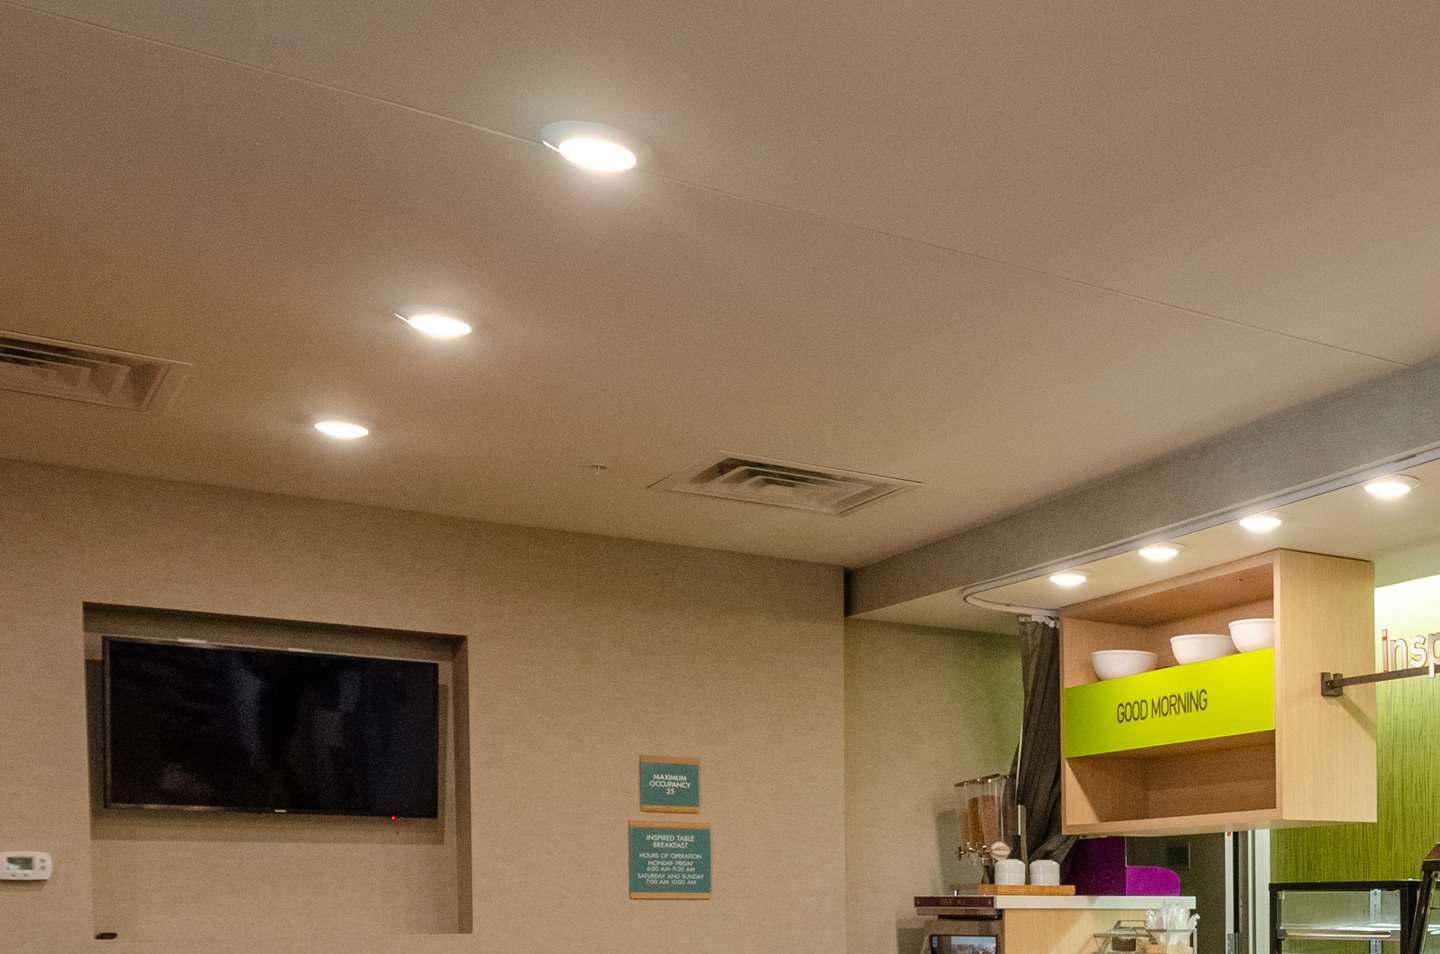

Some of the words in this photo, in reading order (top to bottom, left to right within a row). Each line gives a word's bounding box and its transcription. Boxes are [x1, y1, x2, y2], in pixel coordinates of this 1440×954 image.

[1117, 700, 1148, 723] GOOD
[1151, 689, 1208, 719] MORNING
[653, 773, 687, 781] MAXIMUM
[649, 780, 691, 788] OCCUPANCY
